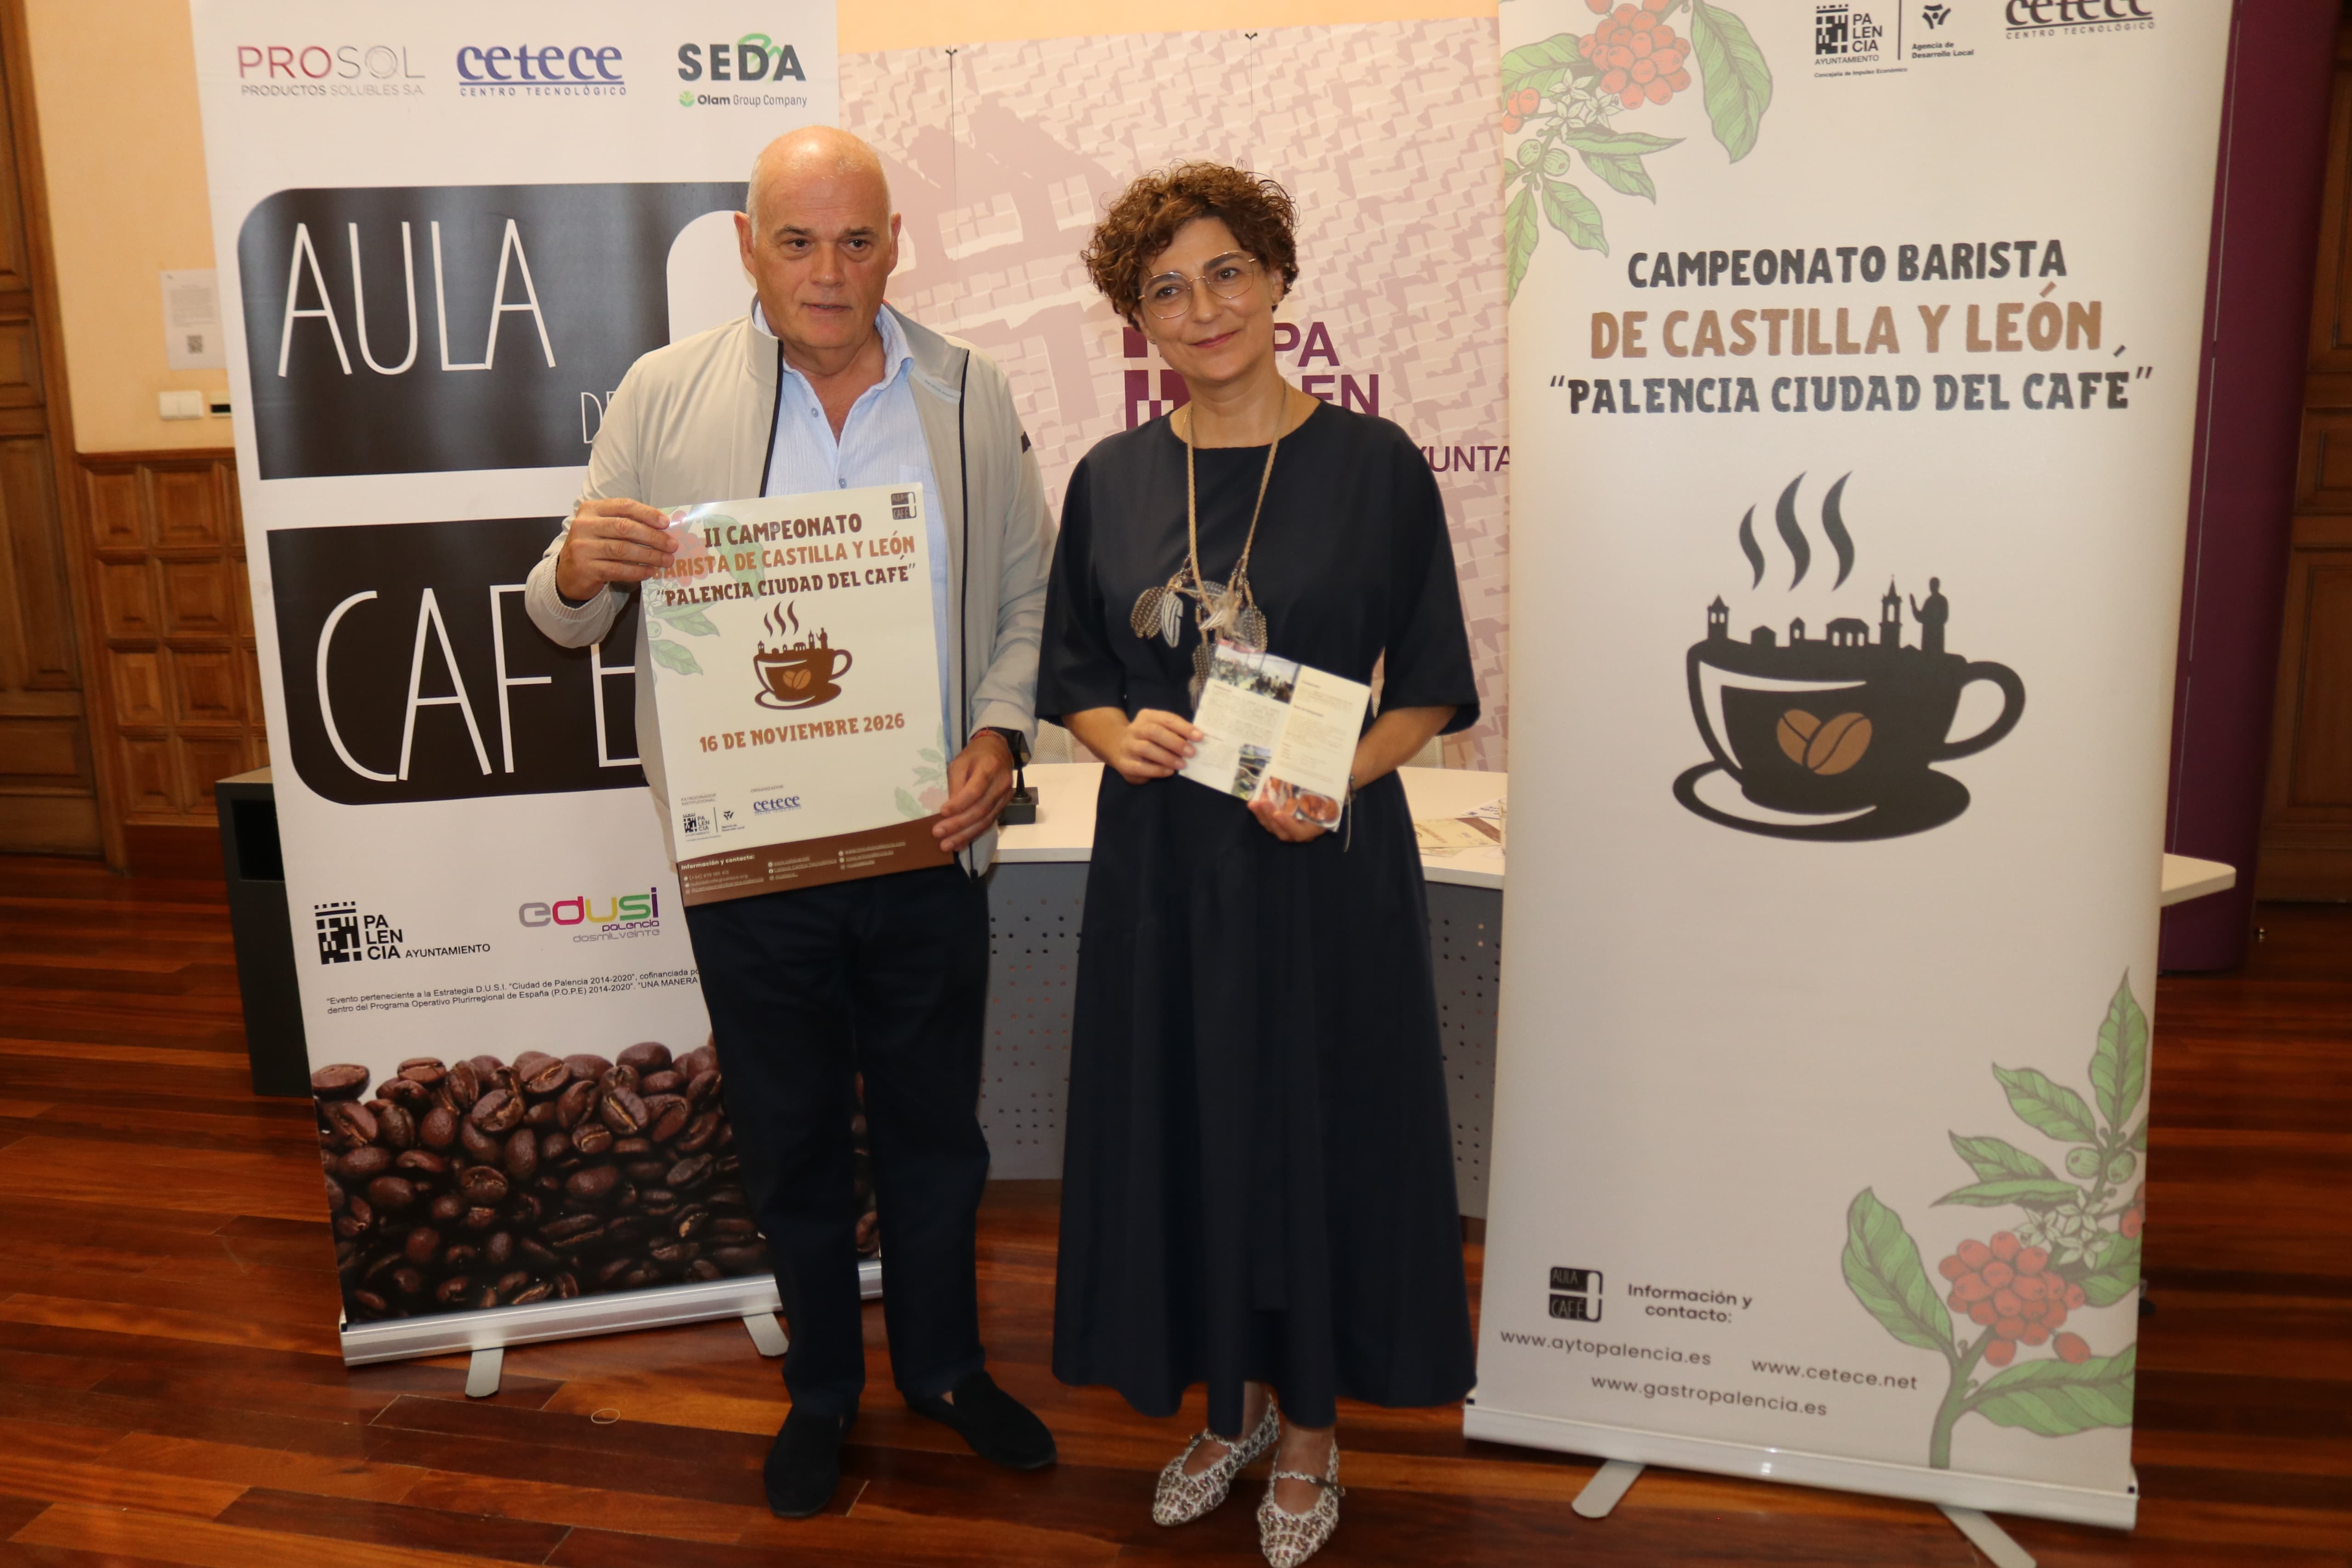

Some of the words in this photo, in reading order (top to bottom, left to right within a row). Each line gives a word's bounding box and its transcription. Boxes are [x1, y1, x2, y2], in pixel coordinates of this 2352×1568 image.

[1854, 13, 1872, 25] PA
[2006, 29, 2055, 40] CENTRO
[2064, 22, 2155, 34] TECNOLÓGICO
[1853, 26, 1883, 39] LEN
[1852, 40, 1878, 52] CIA
[237, 45, 426, 79] PROSOL
[457, 44, 622, 80] cetece
[678, 43, 806, 81] SEDA
[1815, 55, 1879, 65] AYUNTAMIENTO
[241, 85, 326, 96] PRODUCTOS
[331, 85, 399, 96] SOLUBLES
[460, 88, 515, 96] CENTRO
[526, 85, 626, 96] TECNOLÓGICO
[698, 95, 730, 105] Olam
[733, 95, 761, 107] Group
[763, 95, 807, 108] Company
[1628, 245, 1887, 288] CAMPEONATO
[1897, 239, 2066, 282] BARISTA
[278, 218, 556, 377] AULA
[1591, 311, 1648, 359] DE
[1662, 306, 1900, 358] CASTILLA
[1919, 304, 1951, 353] Y
[1966, 281, 2103, 352] LEÓN
[1550, 374, 1760, 414] “PALENCIA
[1771, 374, 1921, 413] CIUDAD
[1933, 372, 2010, 411] DEL
[2022, 345, 2153, 411] CAFÉ”
[1301, 374, 1379, 417] EN
[704, 527, 721, 548] II
[726, 513, 862, 545] CAMPEONATO
[735, 552, 757, 571] DE
[762, 543, 848, 568] CASTILLA
[852, 541, 864, 558] Y
[869, 530, 915, 556] LEÓN
[757, 574, 823, 596] CIUDAD
[827, 571, 861, 589] DEL
[700, 736, 718, 753] 16
[722, 731, 746, 750] DE
[750, 718, 859, 746] NOVIEMBRE
[864, 713, 905, 732] 2026
[753, 796, 800, 811] cetece
[681, 860, 719, 870] Información
[726, 855, 755, 863] contacto:
[519, 887, 658, 928] edusi
[364, 915, 389, 929] PA
[366, 929, 403, 945] LEN
[368, 945, 401, 960] CIA
[406, 944, 491, 958] AYUNTAMIENTO
[328, 1005, 353, 1014] dentro
[356, 1002, 368, 1011] del
[370, 1000, 409, 1011] Programa
[412, 998, 450, 1008] Operativo
[452, 994, 505, 1005] Plurirregional
[520, 990, 549, 999] España
[661, 977, 698, 987] MANERA
[361, 991, 414, 1003] perteneciente
[434, 987, 474, 997] Estrategia
[476, 984, 507, 993] D.U.S.I.
[555, 978, 588, 987] Palencia
[640, 969, 688, 980] cofinanciada
[1552, 1269, 1578, 1284] AULA
[1551, 1297, 1585, 1319] CAFÉ
[1628, 1284, 1736, 1305] Información
[1742, 1296, 1752, 1309] y
[1645, 1305, 1732, 1323] contacto:
[1500, 1330, 1712, 1366] www.aytopalencia.es
[1752, 1359, 1917, 1390] www.cetece.net
[1591, 1376, 1827, 1415] www.gastropalencia.es
